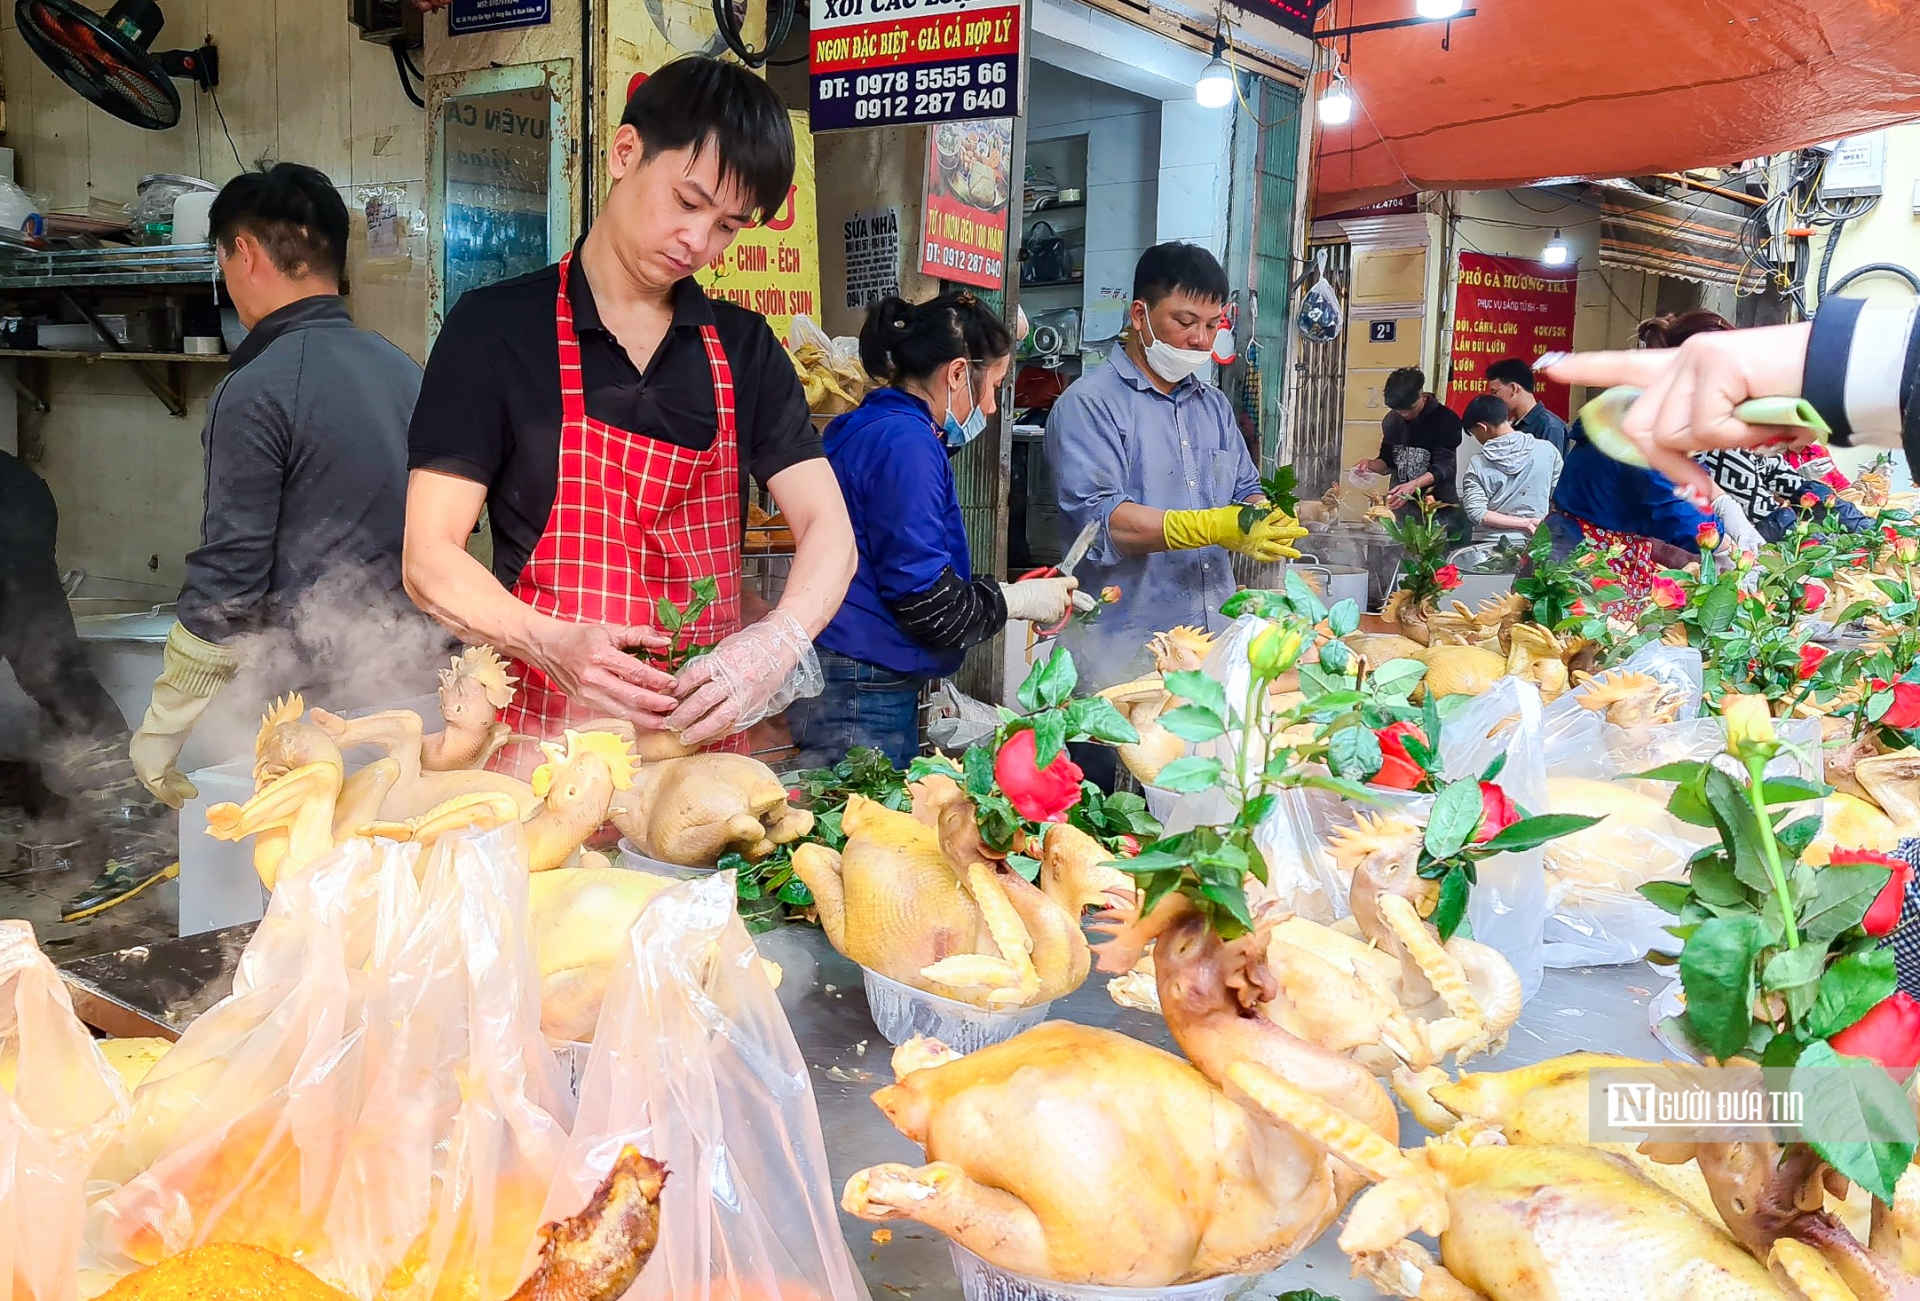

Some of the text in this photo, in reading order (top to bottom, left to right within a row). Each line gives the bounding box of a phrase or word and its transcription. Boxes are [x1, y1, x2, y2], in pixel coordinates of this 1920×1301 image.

[816, 11, 1012, 64] NGON ĐẶC BIỆT GIÁ CẢ HỢP LÝ
[819, 62, 1007, 99] ĐT: 0978 5555 66
[855, 88, 1006, 120] 0912 287 640
[844, 209, 897, 240] SỬA NHÀ
[737, 244, 767, 272] CHIM
[778, 238, 800, 273] ẾCH
[926, 242, 1001, 278] ĐT: 0912 287 640
[1458, 266, 1482, 286] PHỞ
[1484, 270, 1501, 288] GÀ
[1503, 274, 1545, 291] HƯƠNG
[1534, 325, 1566, 337] 40K/50K
[1533, 344, 1547, 354] 40K
